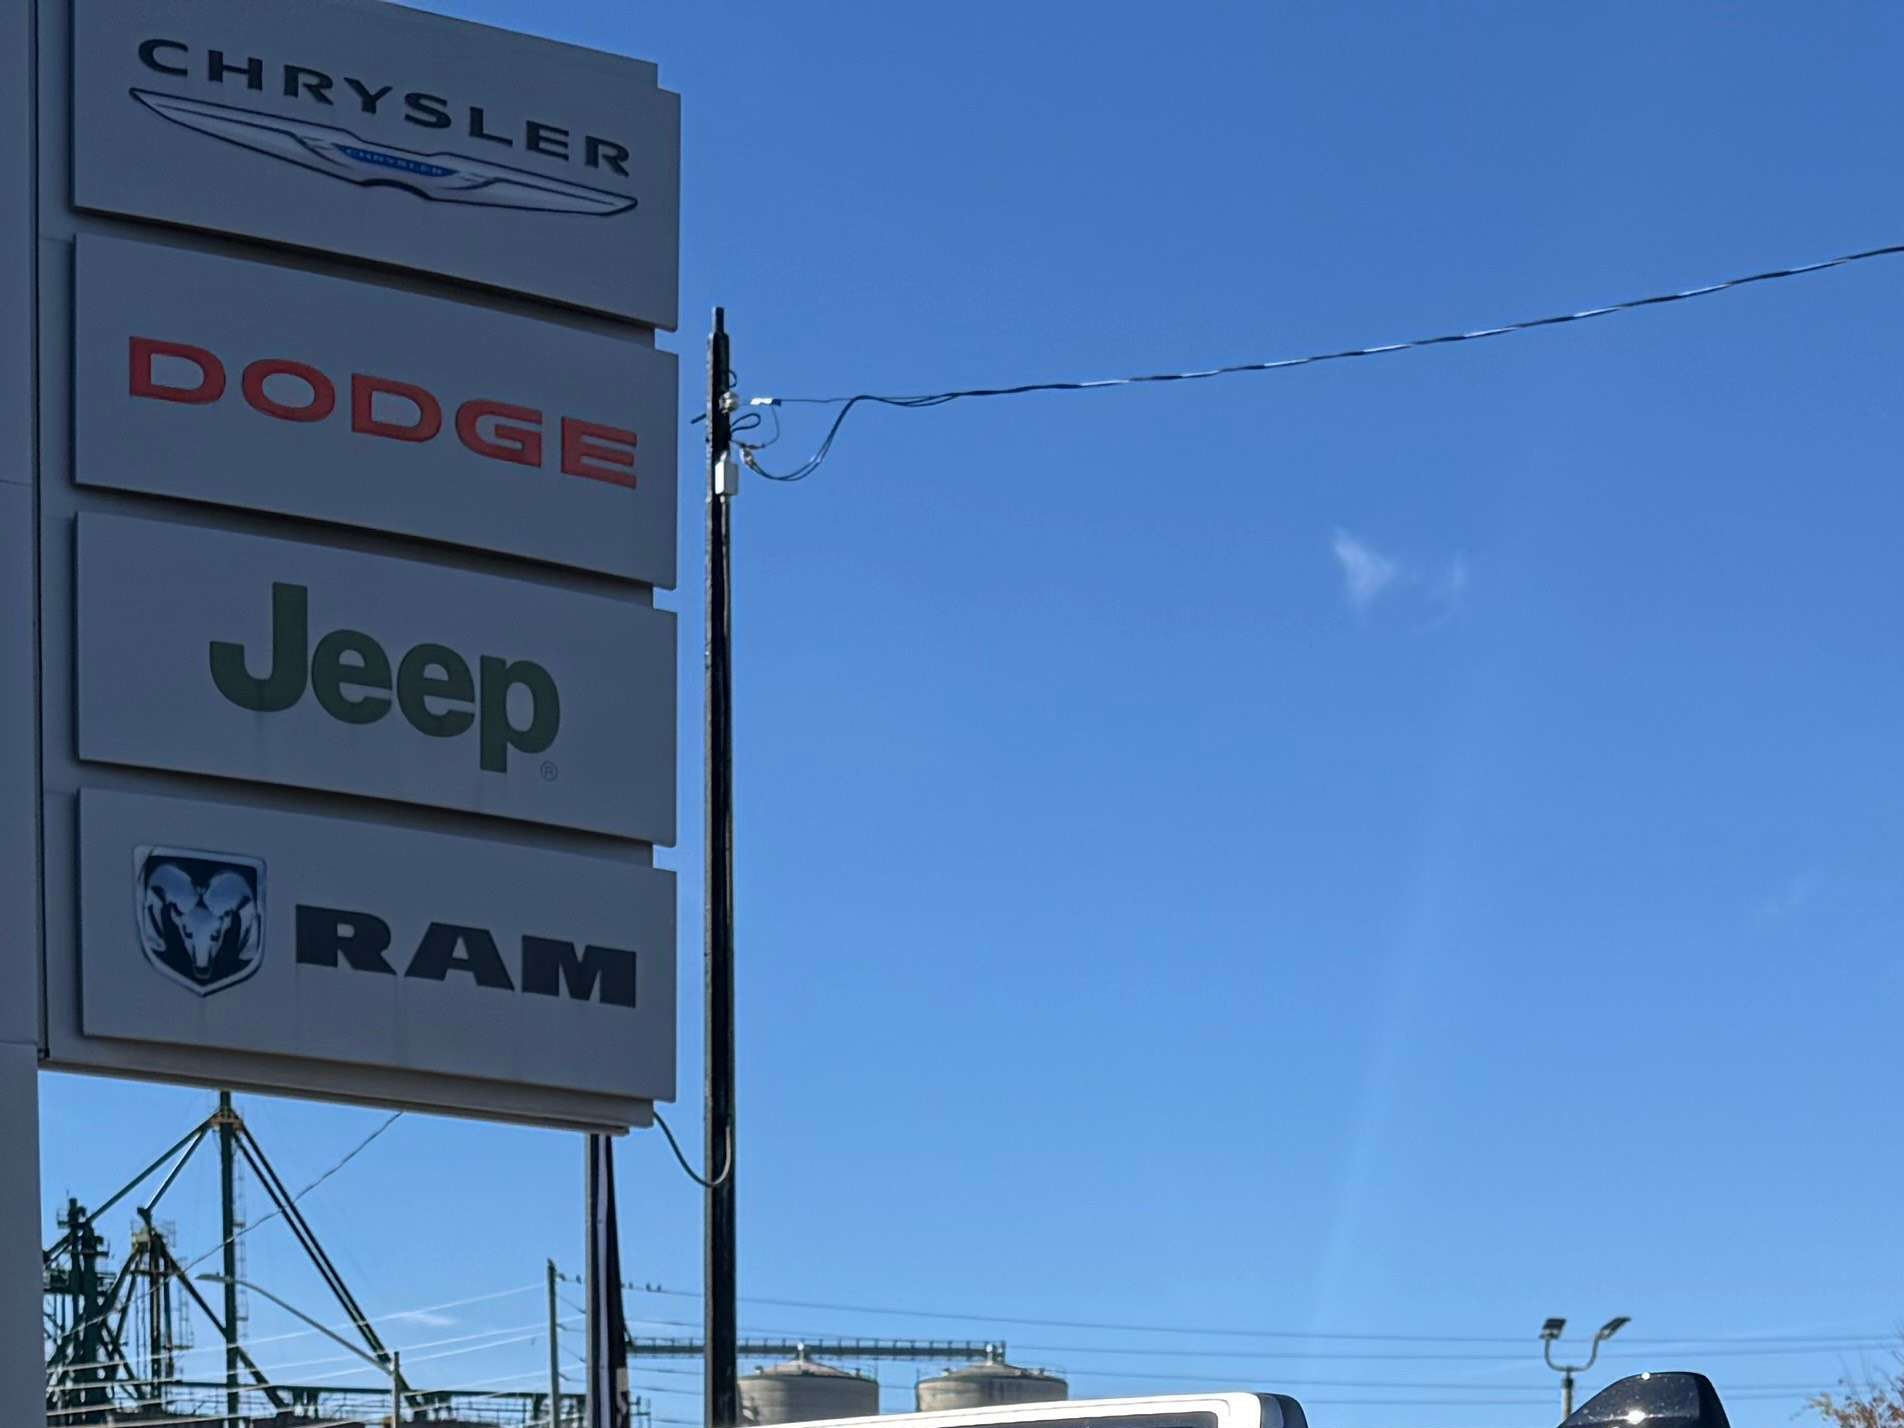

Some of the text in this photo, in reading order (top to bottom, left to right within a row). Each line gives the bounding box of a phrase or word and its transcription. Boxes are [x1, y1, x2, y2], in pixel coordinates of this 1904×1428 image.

[137, 38, 631, 178] CHRYSLER
[129, 335, 638, 490] DODGE
[208, 580, 561, 774] Jeep
[295, 903, 637, 1009] RAM
